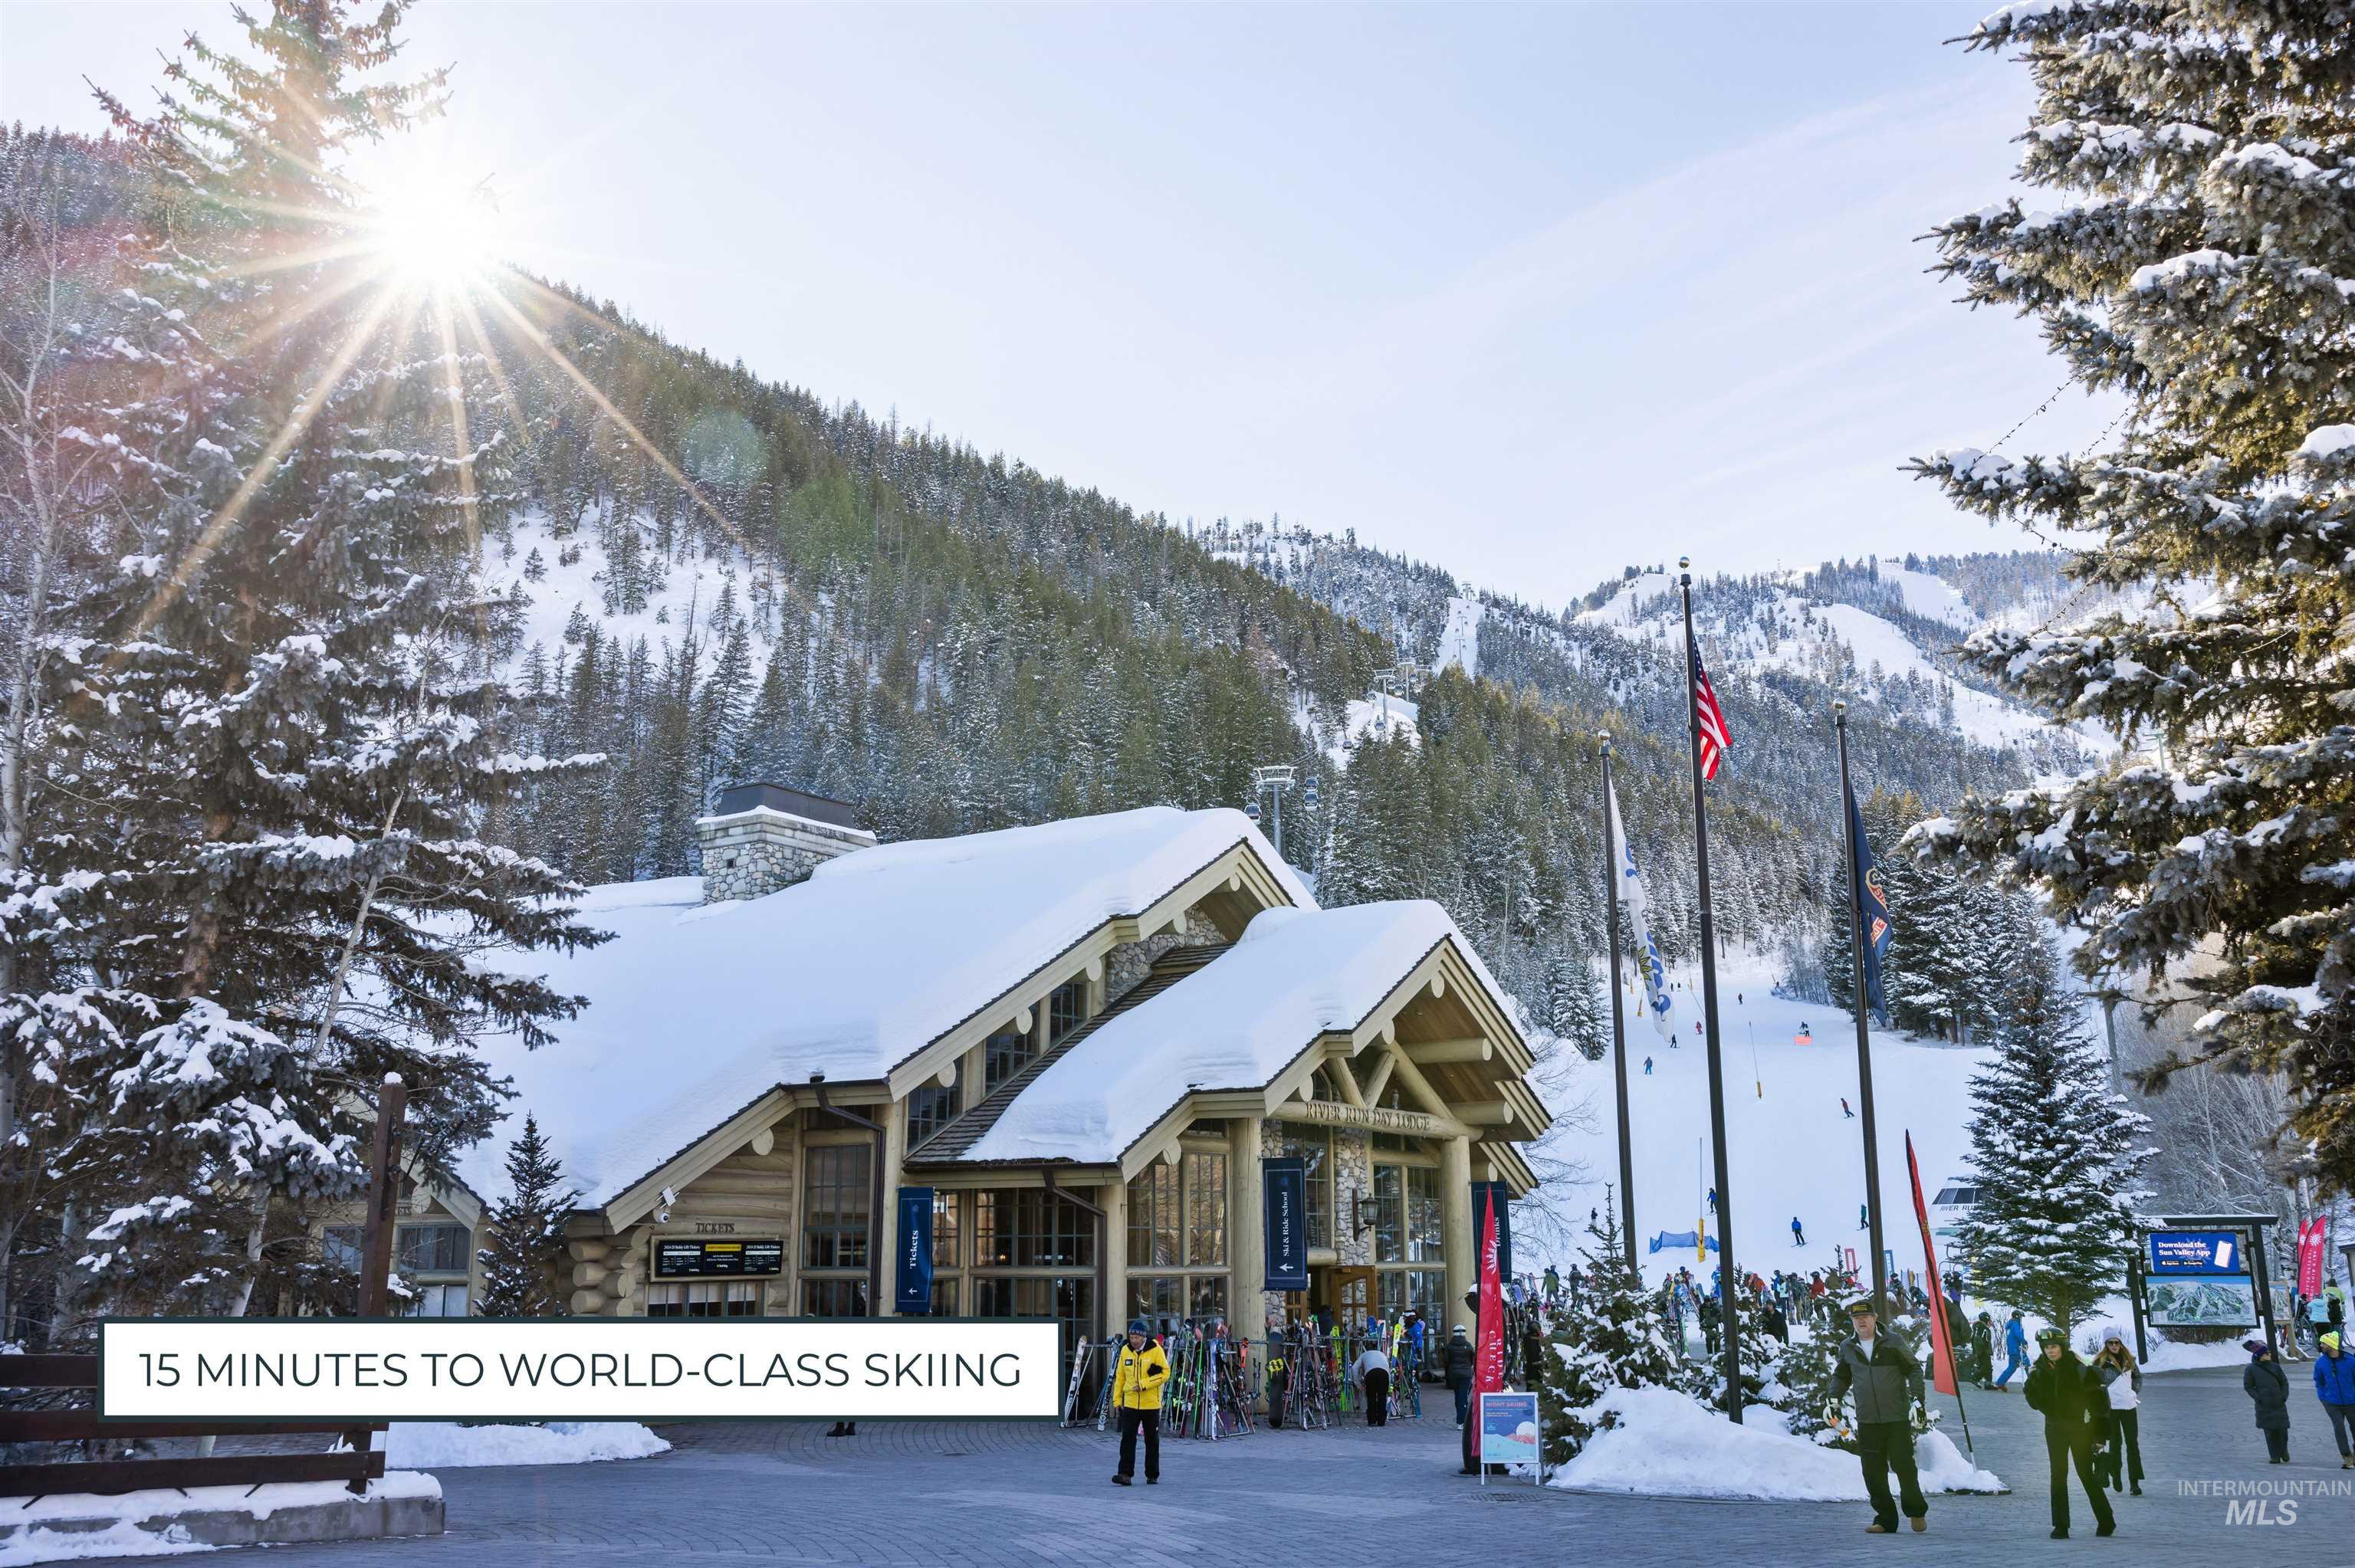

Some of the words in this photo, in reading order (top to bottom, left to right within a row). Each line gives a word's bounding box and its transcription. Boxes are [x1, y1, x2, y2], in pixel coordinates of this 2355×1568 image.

[1306, 1102, 1342, 1122] RIVER
[1345, 1107, 1369, 1124] RUN
[1373, 1110, 1393, 1126] DAY
[1396, 1112, 1431, 1130] LODGE
[695, 1222, 735, 1234] TICKETS
[909, 1229, 919, 1269] Tickets
[1283, 1236, 1289, 1245] &
